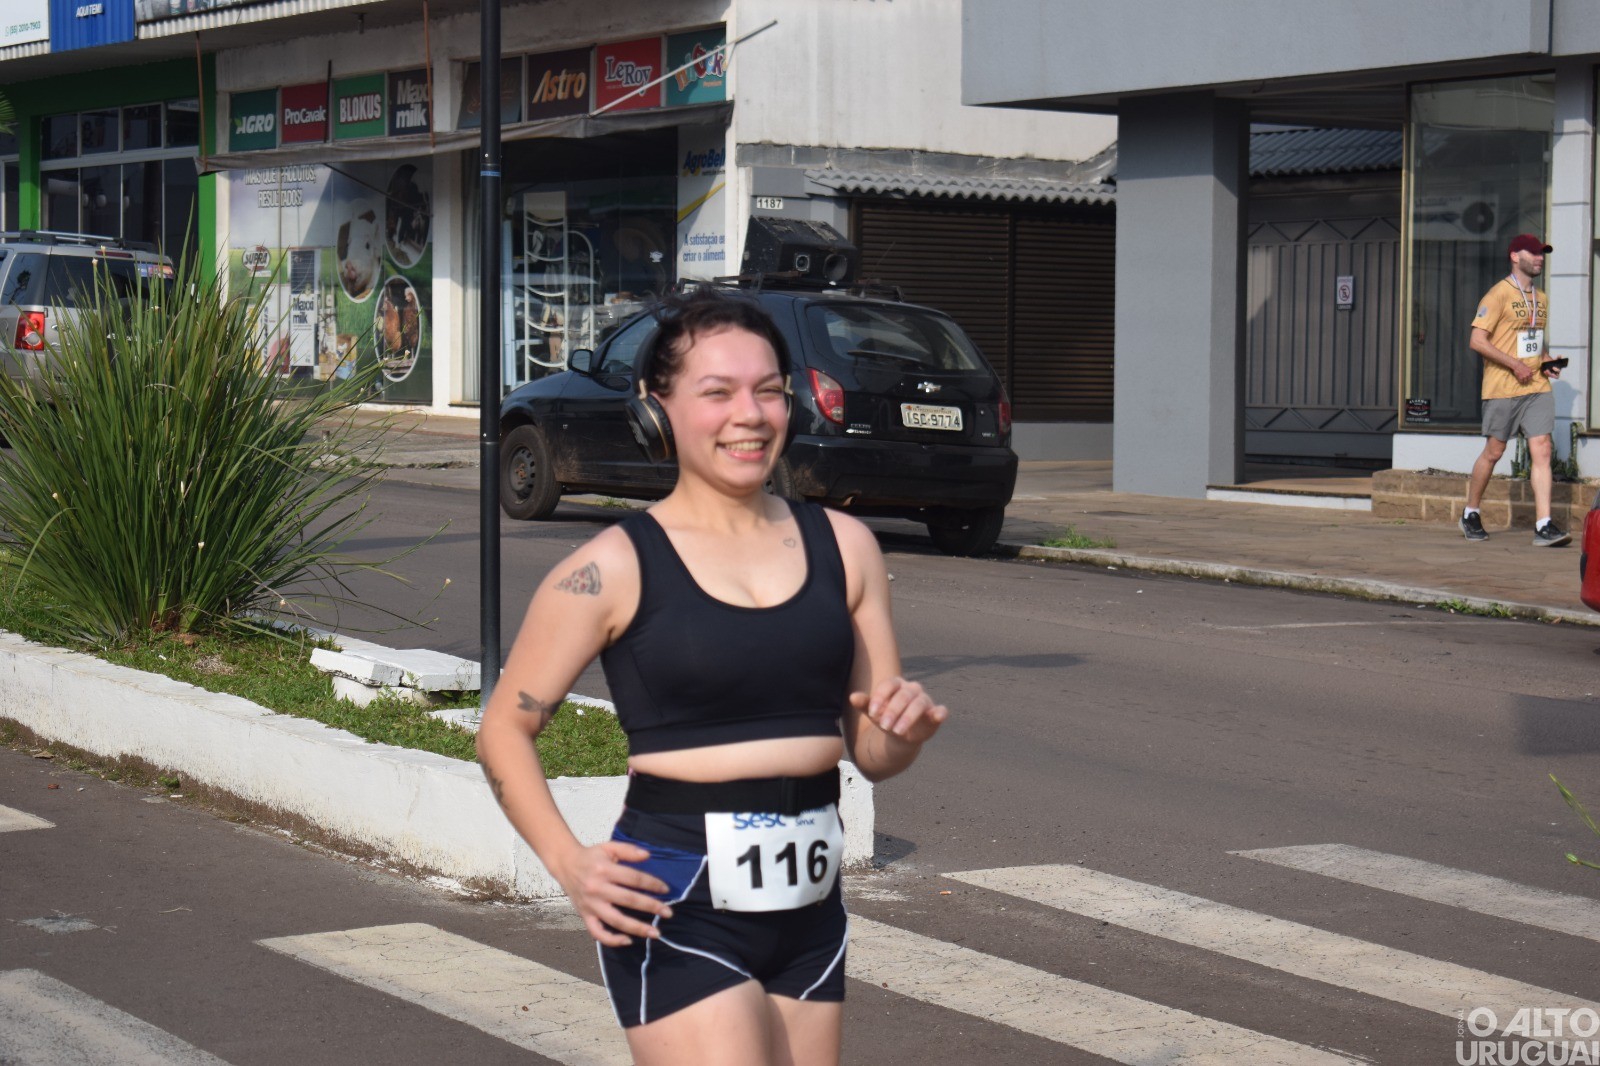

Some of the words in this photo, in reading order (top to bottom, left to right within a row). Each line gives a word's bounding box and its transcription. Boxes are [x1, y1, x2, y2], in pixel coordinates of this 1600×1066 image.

[605, 57, 652, 96] LeRoy
[532, 68, 587, 104] Astro
[339, 94, 382, 123] BLOKUS
[396, 103, 427, 129] milk
[236, 113, 275, 135] AGRO
[683, 149, 726, 174] AgroBell
[757, 199, 782, 208] 1187
[690, 232, 718, 246] satisfação
[683, 251, 696, 262] criar
[293, 297, 314, 311] Maxxi
[293, 312, 308, 324] milk
[1515, 310, 1526, 318] 10
[1526, 342, 1538, 352] 89
[736, 839, 829, 889] 116
